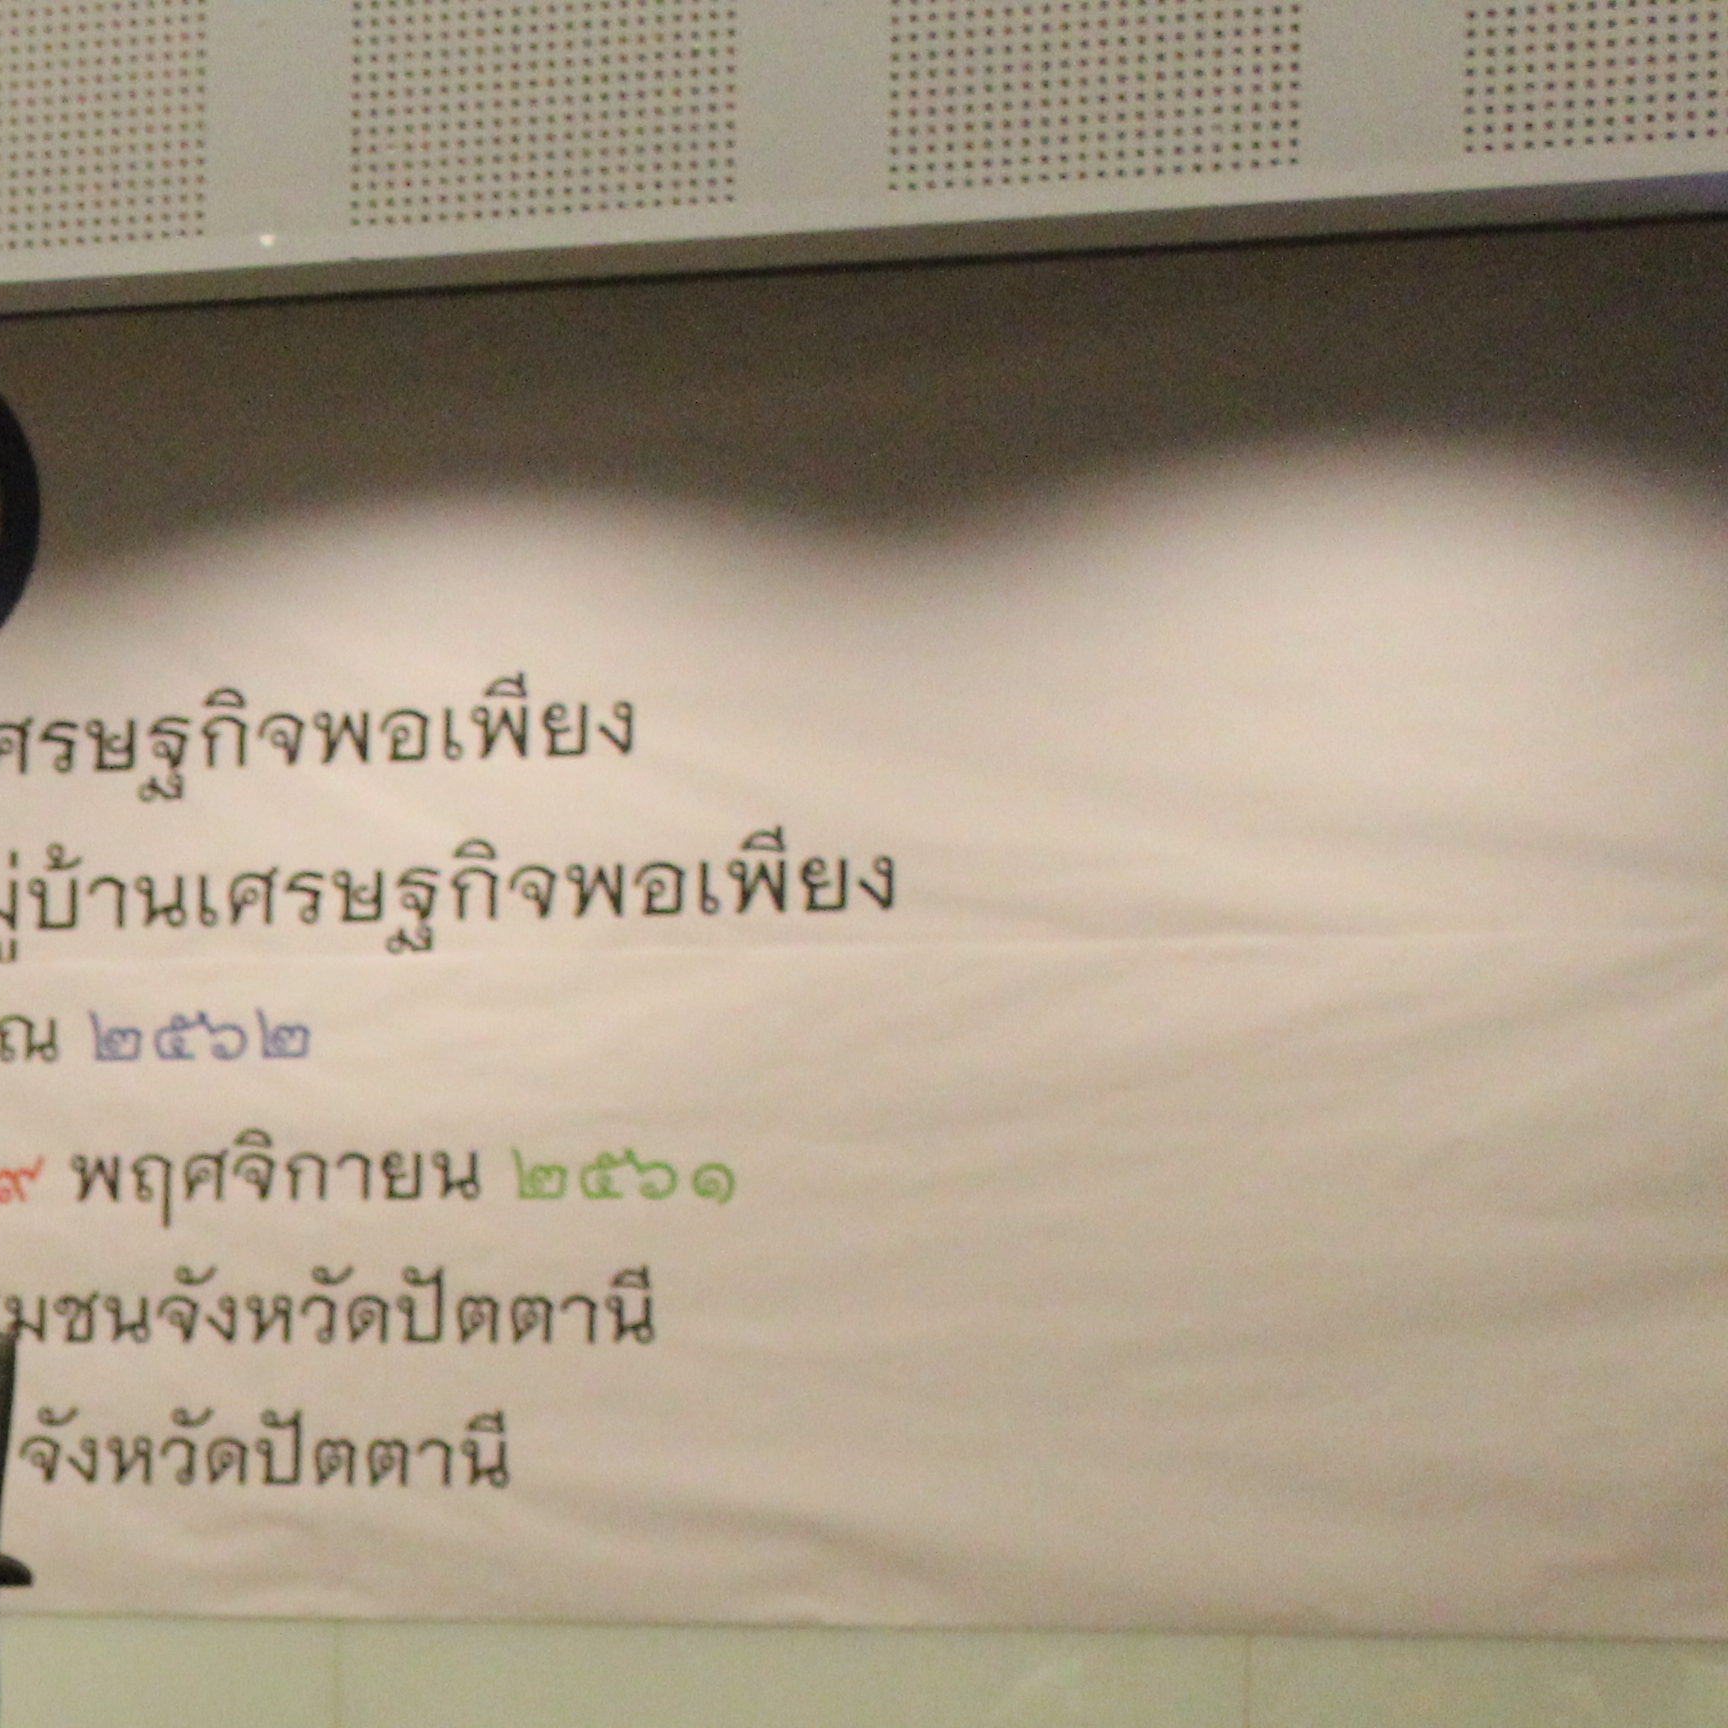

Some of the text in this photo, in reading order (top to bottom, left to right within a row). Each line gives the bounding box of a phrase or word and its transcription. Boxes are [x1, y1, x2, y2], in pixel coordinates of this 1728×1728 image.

[89, 1009, 312, 1061] ๒๕๖๒
[69, 1127, 482, 1229] พฤศจิกายน
[509, 1146, 738, 1207] ๒๕๖๑
[18, 1407, 510, 1490] จังหวัดปัตตานี
